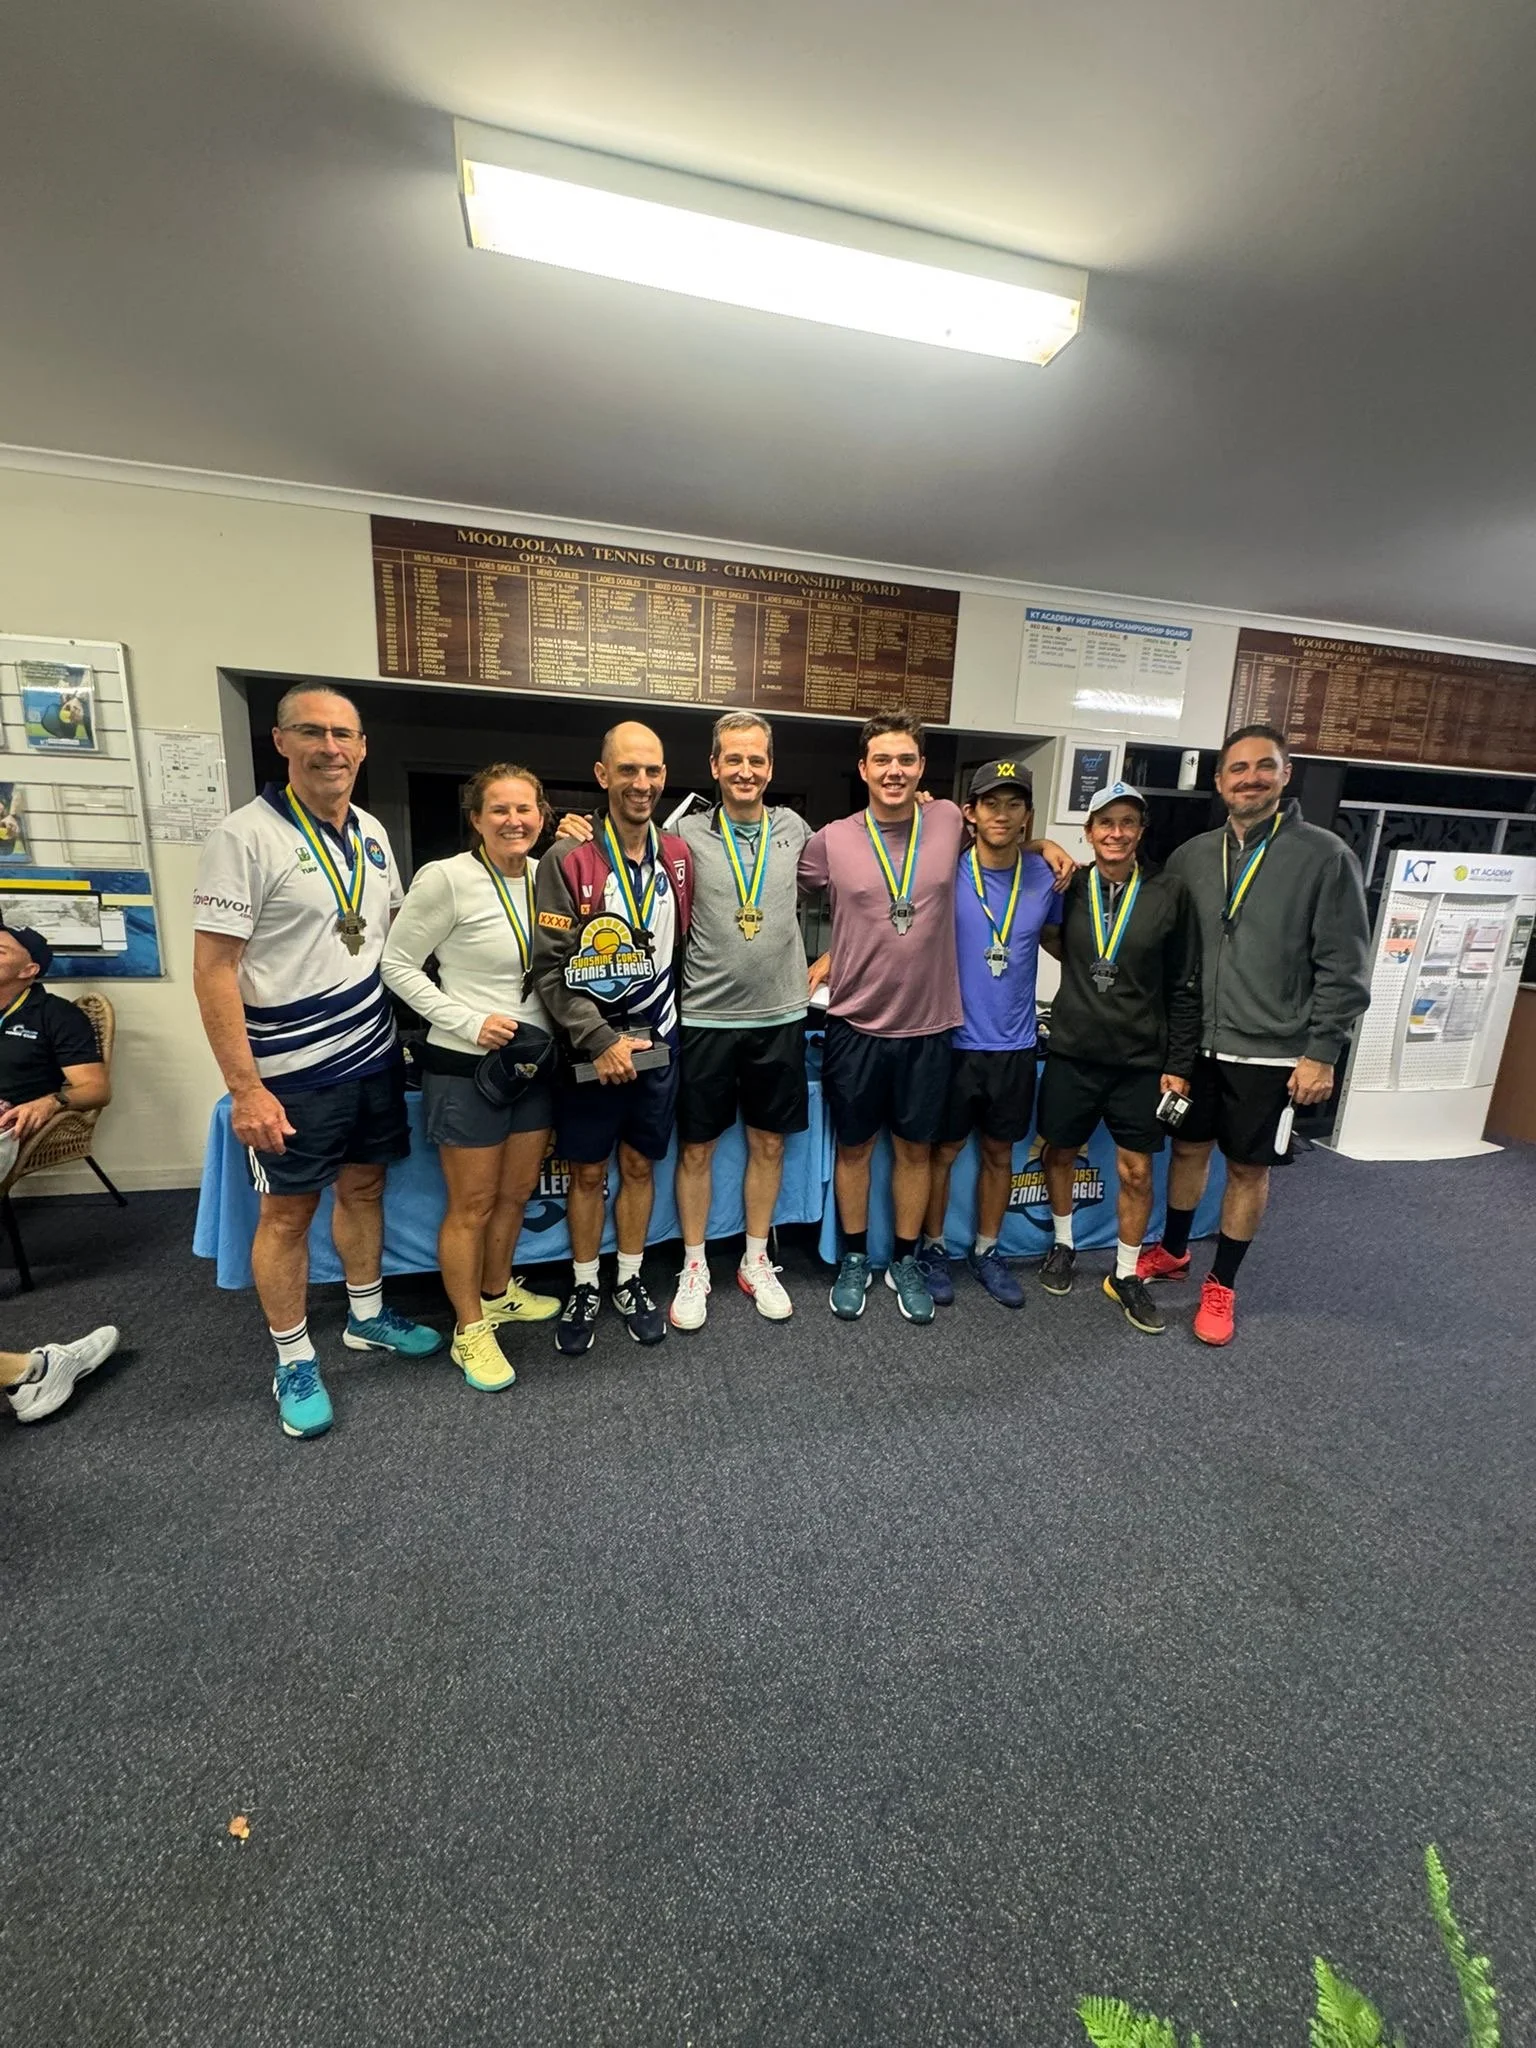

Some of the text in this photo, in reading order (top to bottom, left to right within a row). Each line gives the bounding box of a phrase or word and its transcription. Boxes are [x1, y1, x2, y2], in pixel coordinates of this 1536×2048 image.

[456, 529, 585, 558] MOOLOOLABA
[592, 546, 656, 567] TENNIS
[662, 555, 708, 573] CLUB
[723, 564, 846, 591] CHAMPIONSHIP
[851, 580, 901, 598] BOARD
[518, 552, 558, 566] OPEN
[801, 587, 863, 603] VETERANS
[1030, 611, 1041, 619] KT
[1040, 612, 1076, 624] ACADEMY
[1091, 618, 1114, 629] SHOTS
[1114, 621, 1165, 635] CHAMPIONSHIP
[1165, 627, 1189, 638] BOARD
[1403, 859, 1437, 883] KT
[1481, 868, 1514, 877] ACADEMY
[540, 914, 571, 929] XXXX
[572, 952, 643, 969] SUNSHINE COAST
[567, 962, 652, 983] TENNIS LEAGUE
[1010, 1171, 1046, 1188] SUNSH
[1009, 1181, 1104, 1206] ENNIS AGUE
